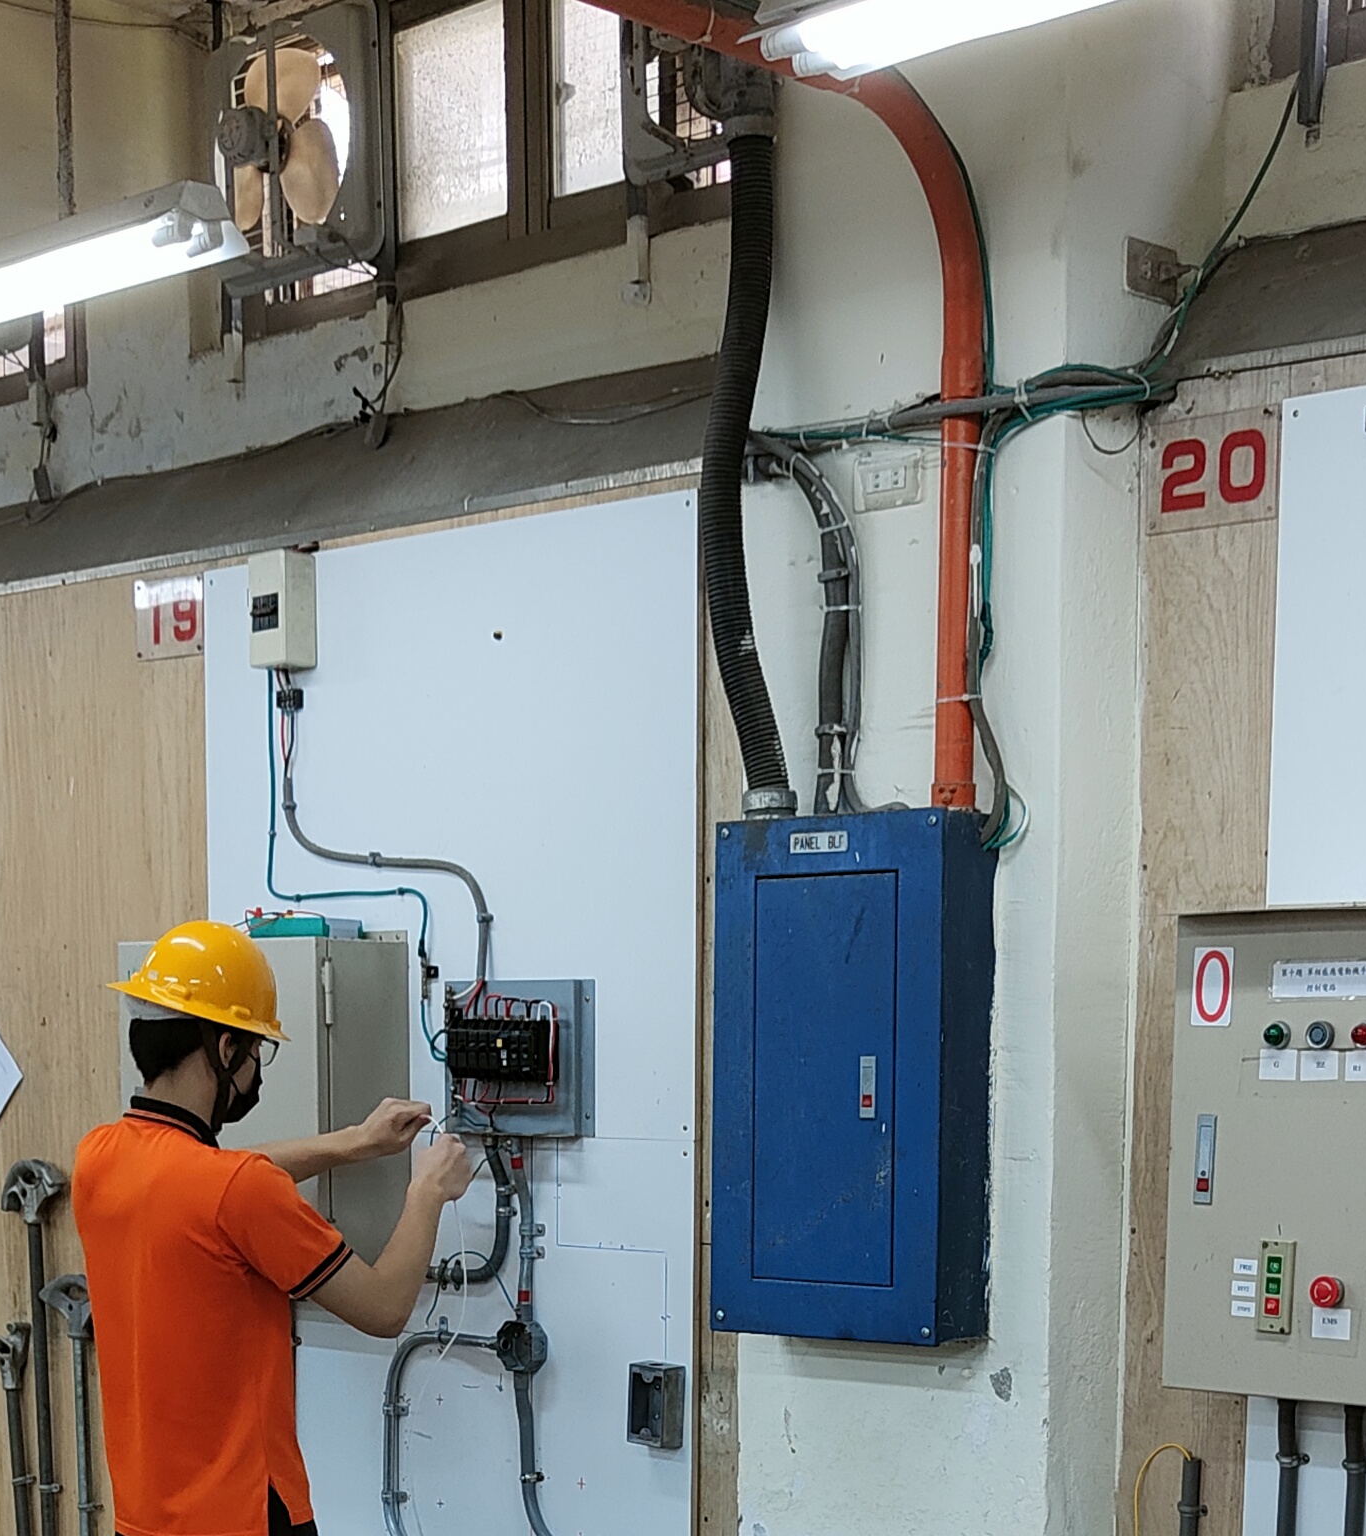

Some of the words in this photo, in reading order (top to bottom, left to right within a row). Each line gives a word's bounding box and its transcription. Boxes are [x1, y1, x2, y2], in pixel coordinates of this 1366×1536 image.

[1161, 428, 1266, 514] 20
[150, 591, 197, 645] 19
[793, 836, 820, 850] PANEL
[1277, 1224, 1282, 1236] 1
[1322, 1317, 1338, 1326] EMS
